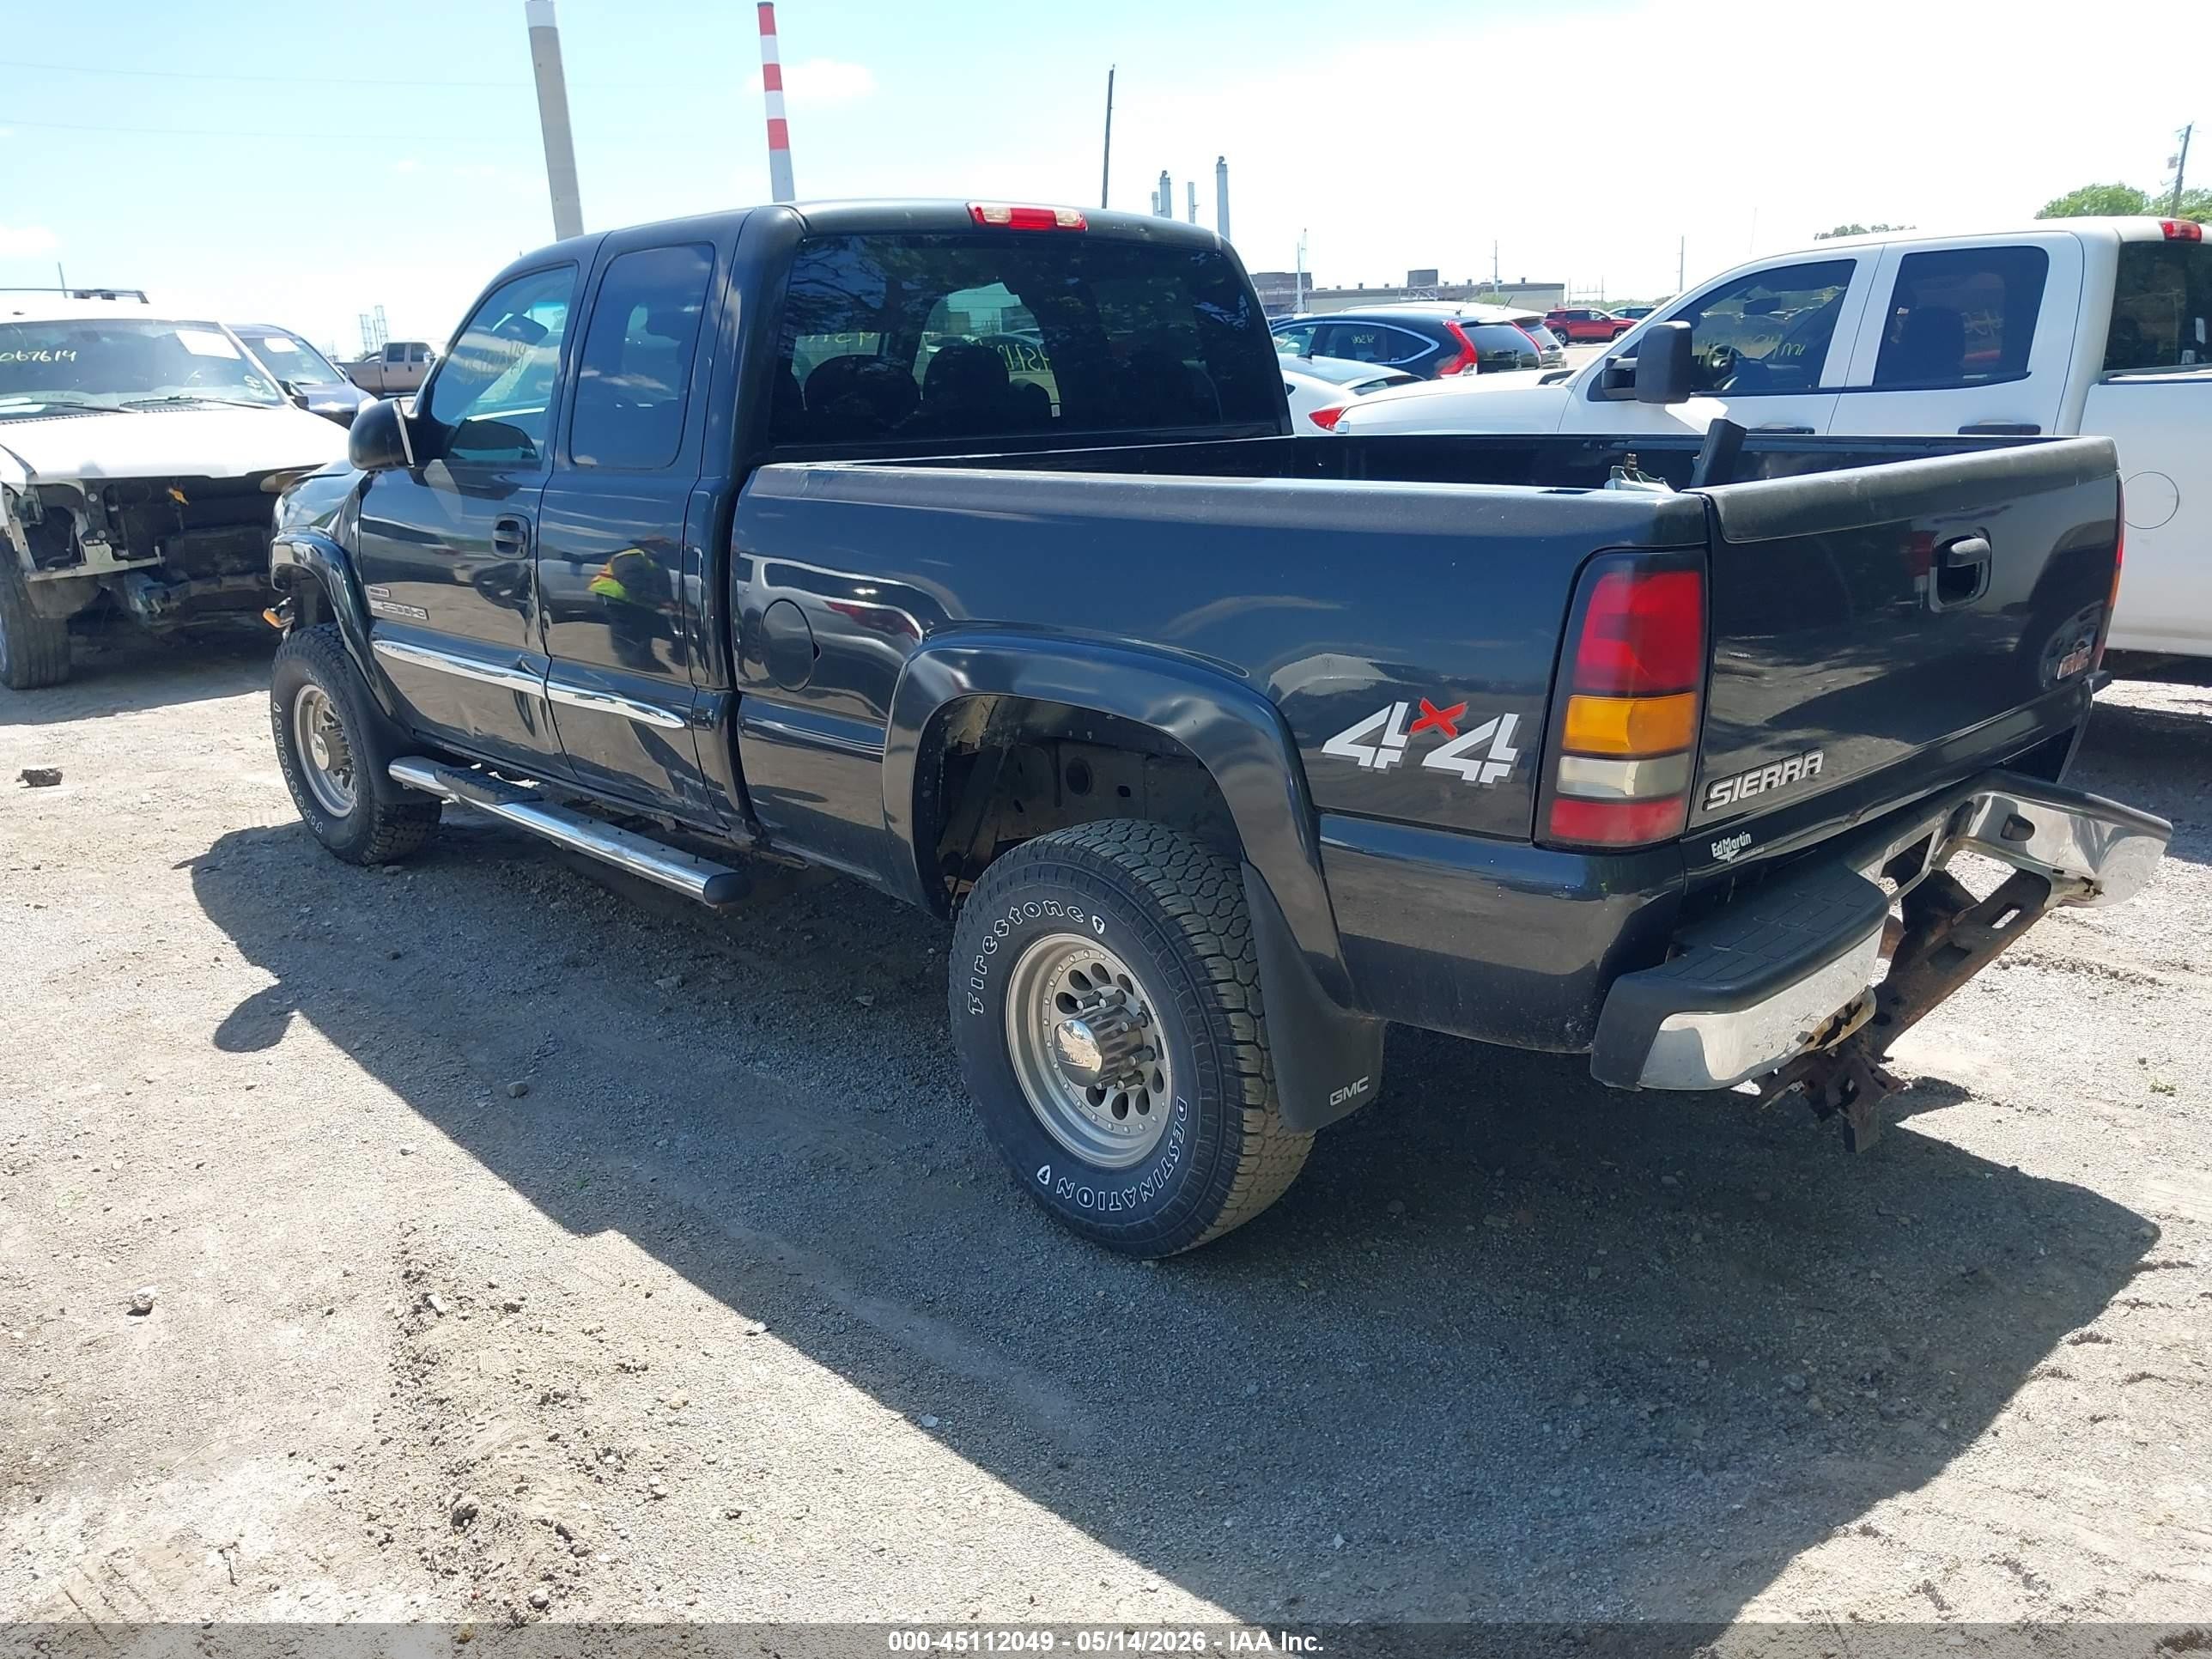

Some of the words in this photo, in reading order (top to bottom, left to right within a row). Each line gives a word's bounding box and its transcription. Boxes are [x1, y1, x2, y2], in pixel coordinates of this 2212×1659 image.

[1704, 748, 1825, 811] SIERRA
[967, 899, 1085, 1016] Firestone
[1329, 1075, 1369, 1106] GMC
[1055, 1095, 1188, 1212] DESTINATION
